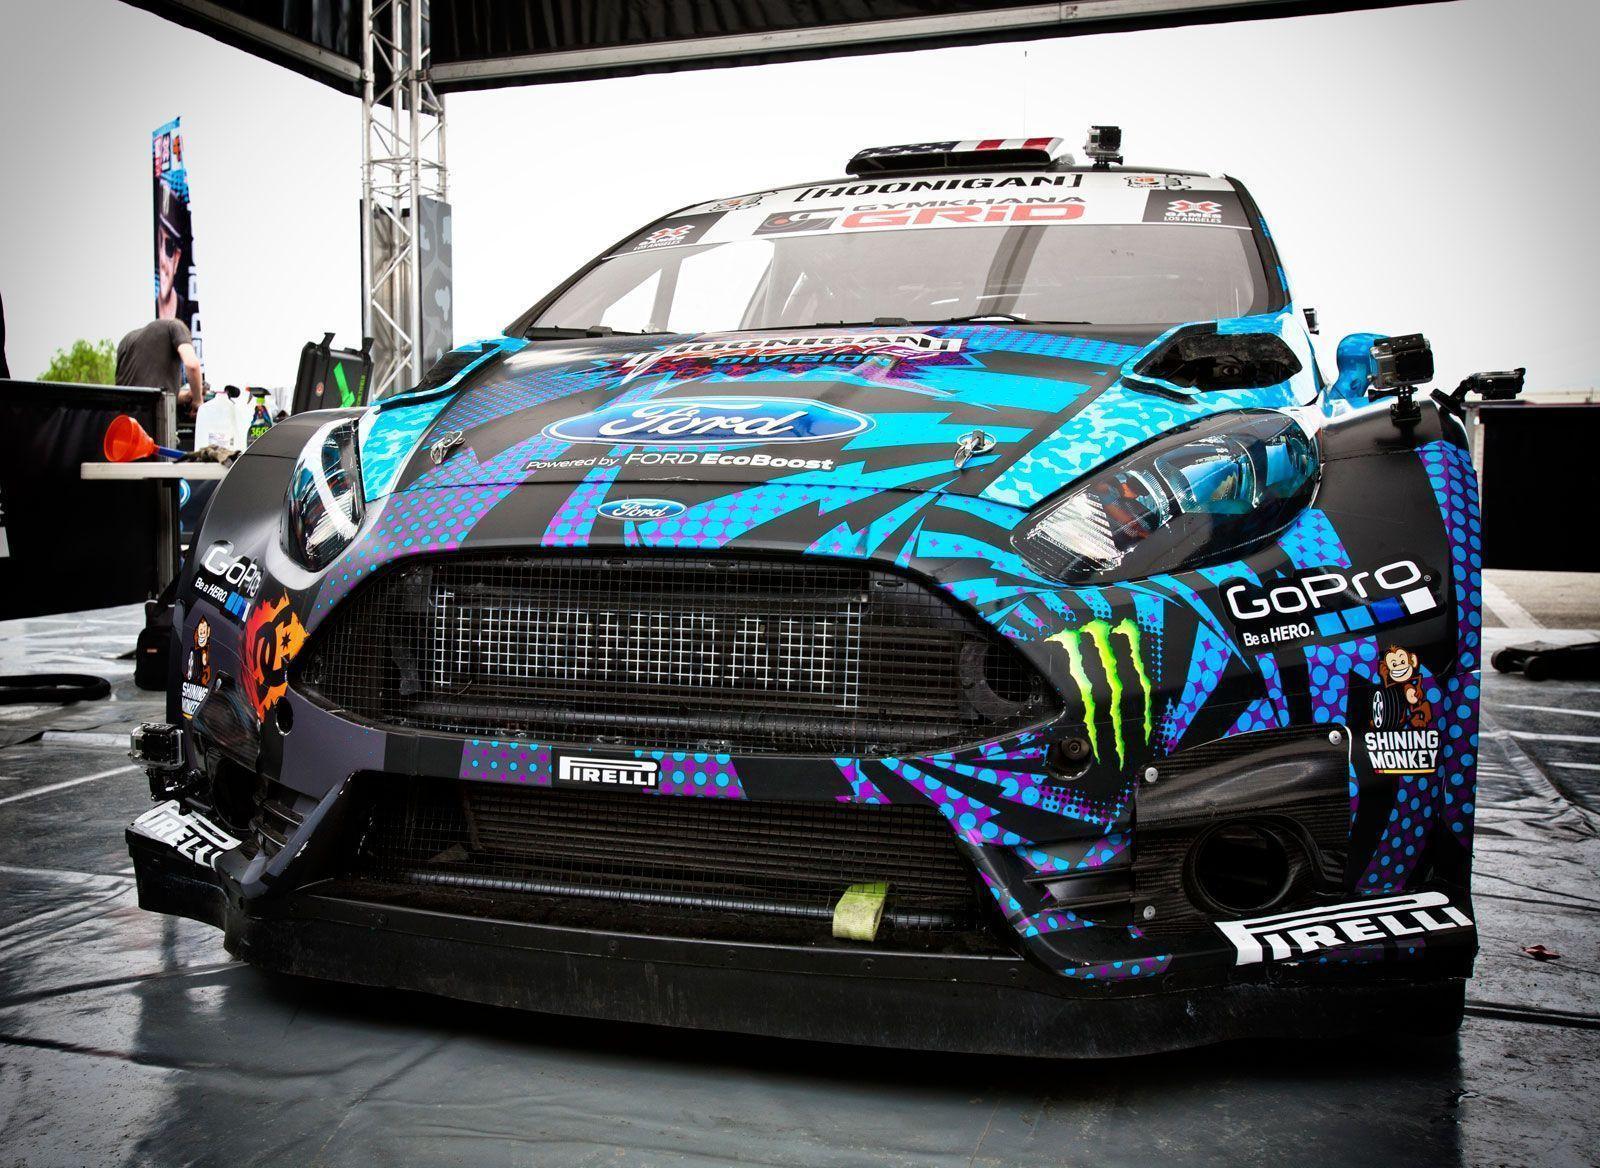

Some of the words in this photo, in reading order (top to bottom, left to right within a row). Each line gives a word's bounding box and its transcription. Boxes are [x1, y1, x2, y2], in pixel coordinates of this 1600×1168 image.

[853, 196, 1086, 212] GYMKHANA
[712, 354, 892, 367] DIVISION
[599, 402, 809, 436] Ford
[526, 457, 597, 469] Powered
[597, 457, 620, 467] by
[625, 453, 698, 466] FORD
[699, 453, 834, 470] EcoBoost
[612, 501, 671, 517] Ford
[204, 546, 262, 598] GoPro
[195, 577, 205, 590] Be
[203, 584, 209, 593] a
[1226, 560, 1422, 620] GoPro
[1242, 632, 1260, 647] Be
[1261, 633, 1269, 644] a
[1269, 622, 1315, 643] HERO.
[1364, 730, 1439, 751] SHINING
[1368, 749, 1439, 769] MONKEY
[559, 755, 658, 786] PIRELLI
[1214, 891, 1474, 966] PIRELLI
